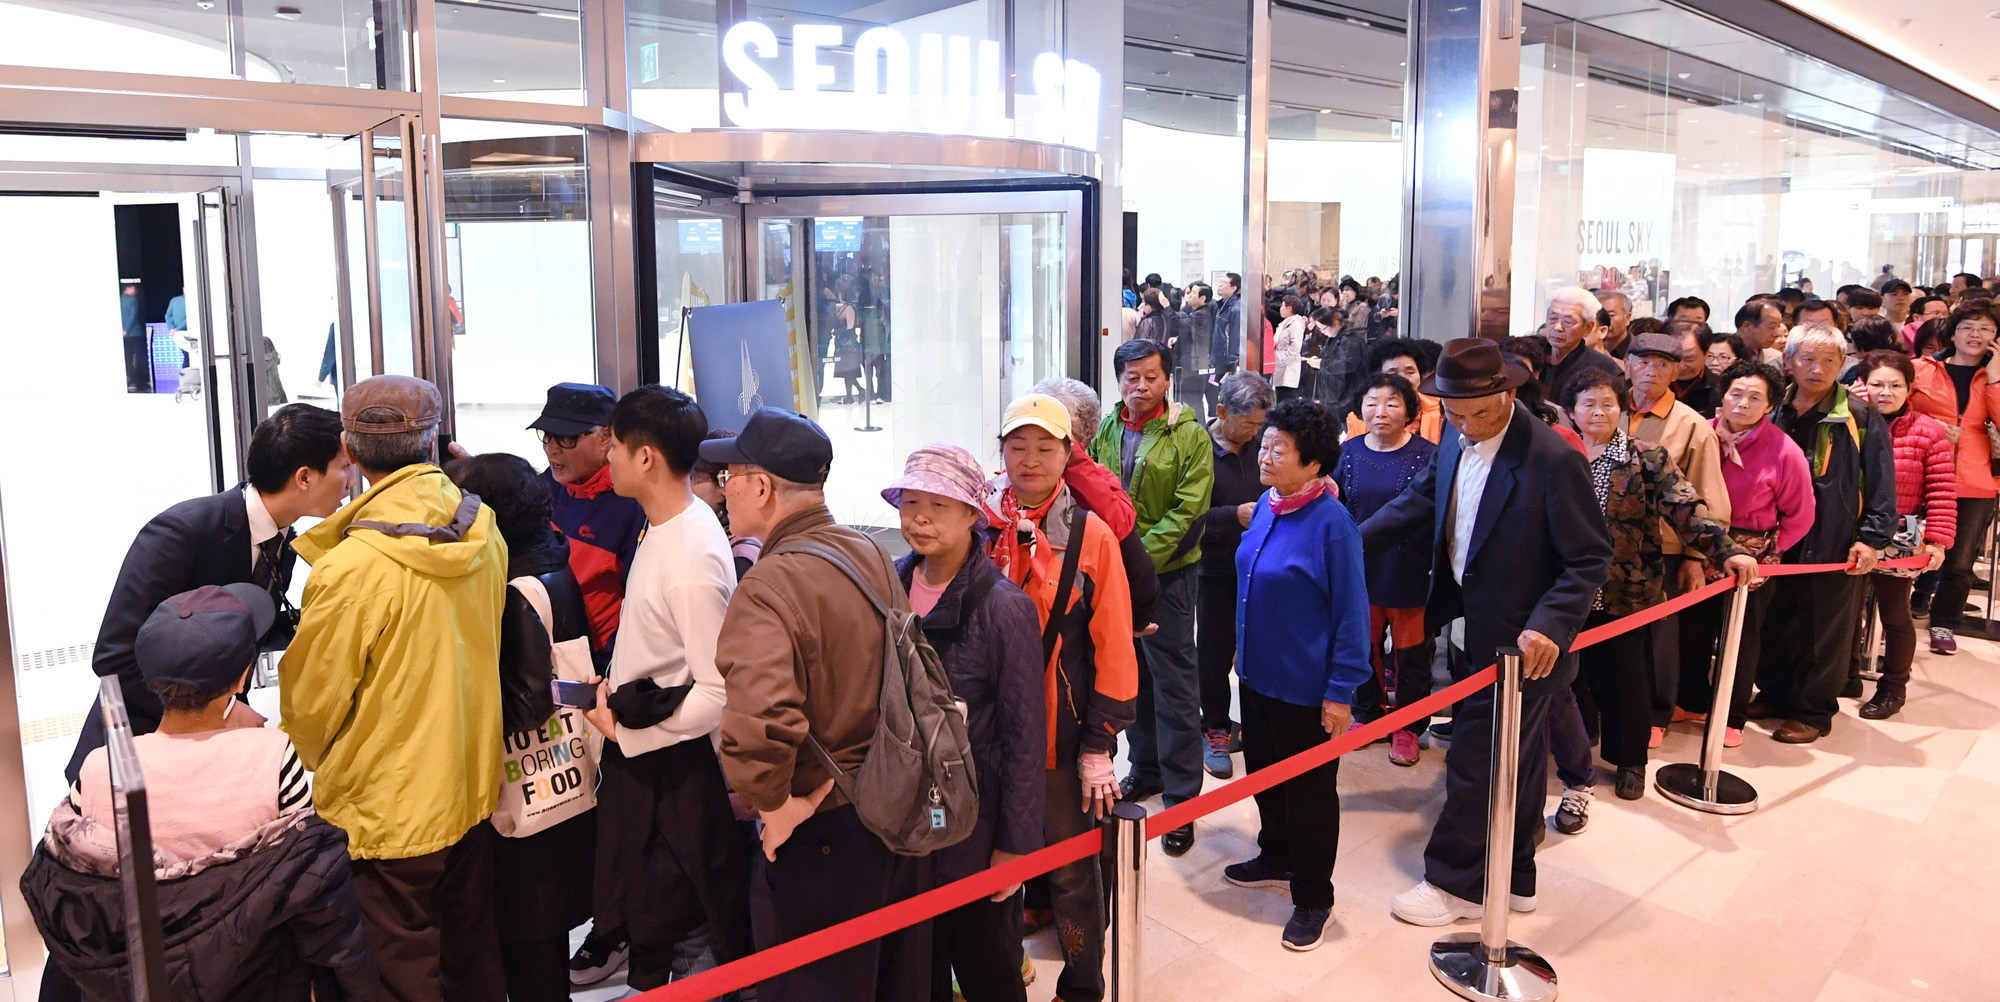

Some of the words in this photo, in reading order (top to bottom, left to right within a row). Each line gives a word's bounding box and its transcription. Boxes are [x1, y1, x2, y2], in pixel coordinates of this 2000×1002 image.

[722, 20, 1014, 137] SEOUL
[1577, 219, 1621, 255] SEOUL
[1628, 221, 1653, 254] SKY
[503, 729, 531, 755] TO
[536, 712, 573, 744] EAT
[504, 737, 585, 783] BORING
[522, 766, 582, 805] FOOD
